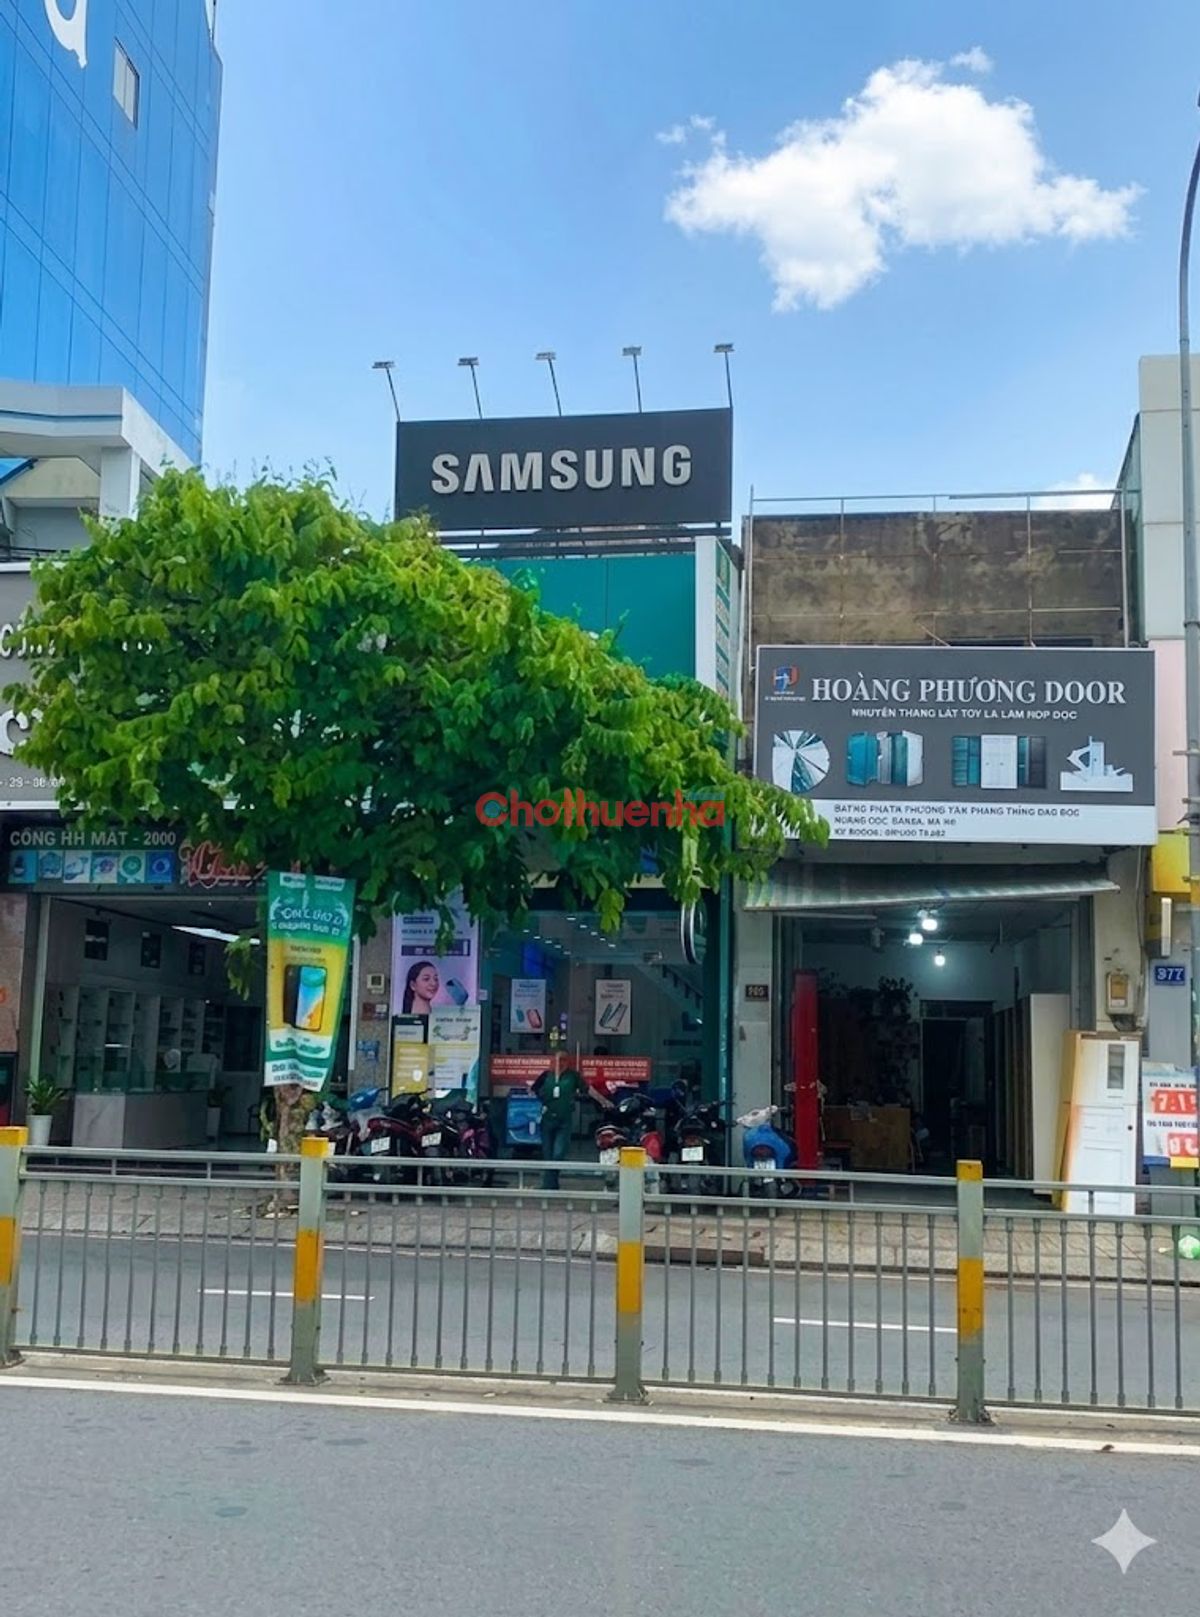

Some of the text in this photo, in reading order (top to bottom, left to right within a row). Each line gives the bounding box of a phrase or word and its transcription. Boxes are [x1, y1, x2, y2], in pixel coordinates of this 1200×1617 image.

[431, 445, 692, 495] SAMSUNG
[811, 671, 1127, 704] HOÀNG PHƯƠNG DOOR
[143, 830, 177, 847] 2000
